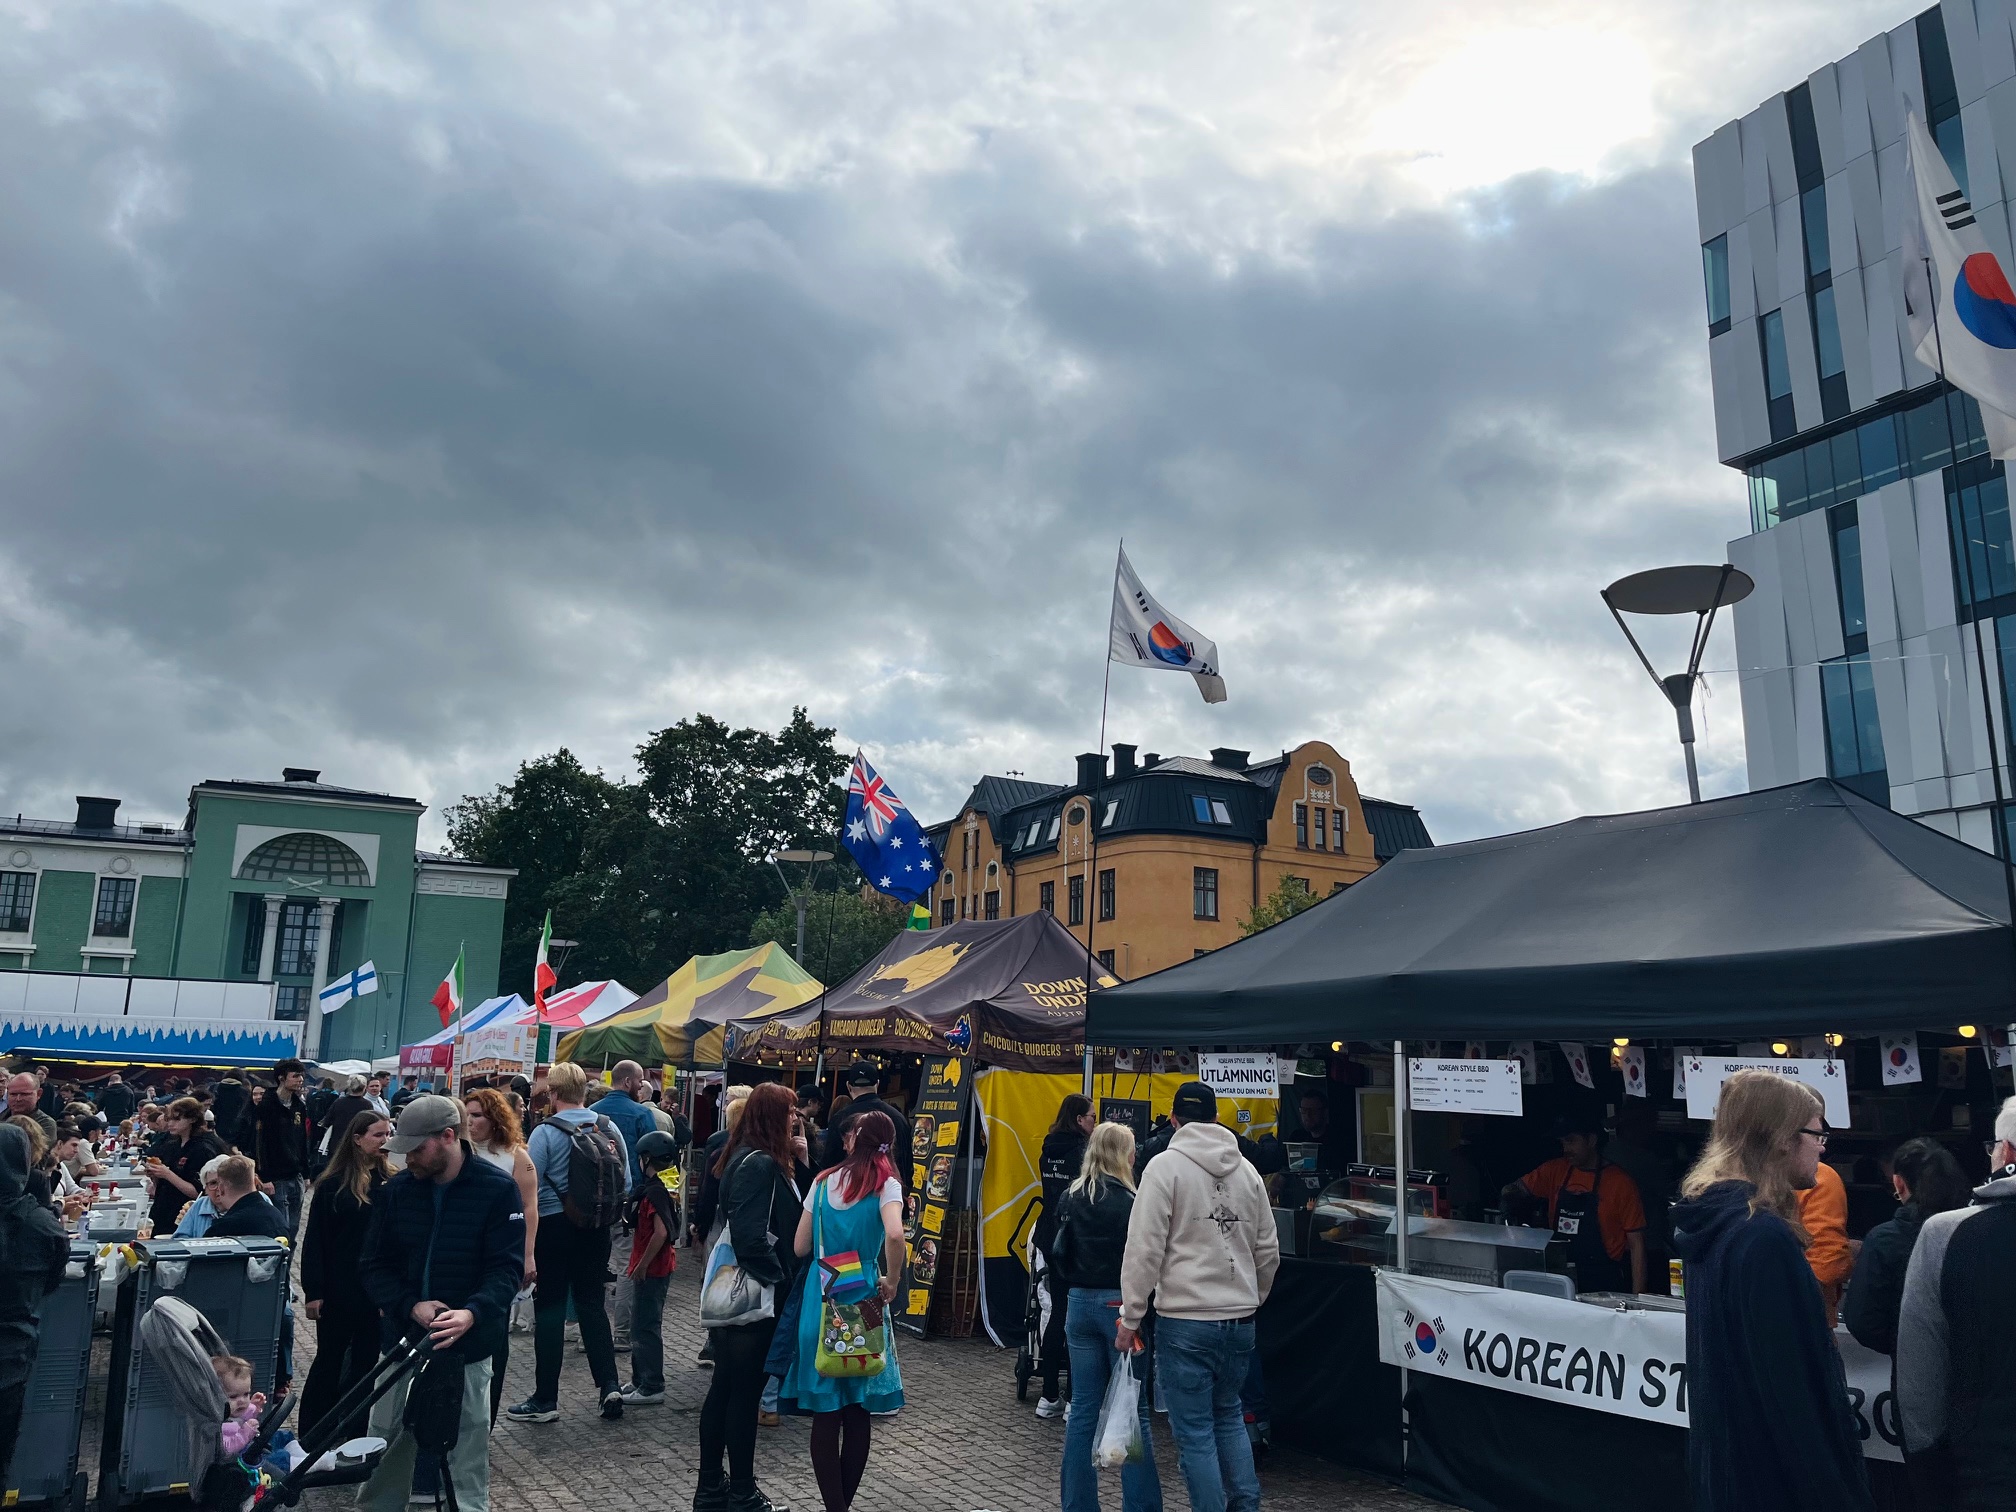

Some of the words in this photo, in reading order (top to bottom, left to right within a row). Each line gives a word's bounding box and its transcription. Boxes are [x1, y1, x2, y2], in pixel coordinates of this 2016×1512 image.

[1021, 976, 1087, 995] DOWN
[1032, 991, 1087, 1009] UNDE
[1047, 1010, 1086, 1018] AUSTR
[830, 1020, 857, 1036] KANGAROO
[857, 1018, 886, 1036] BURGERS
[894, 1018, 911, 1036] COLD
[983, 1031, 1024, 1055] CROCODILE
[1025, 1043, 1061, 1057] BURGERS
[1201, 1066, 1276, 1083] UTLÄMNING!
[1437, 1064, 1459, 1072] KOREAN
[1782, 1066, 1799, 1075] BBQ
[1463, 1328, 1625, 1400] KOREAN
[1639, 1358, 1687, 1413] ST
